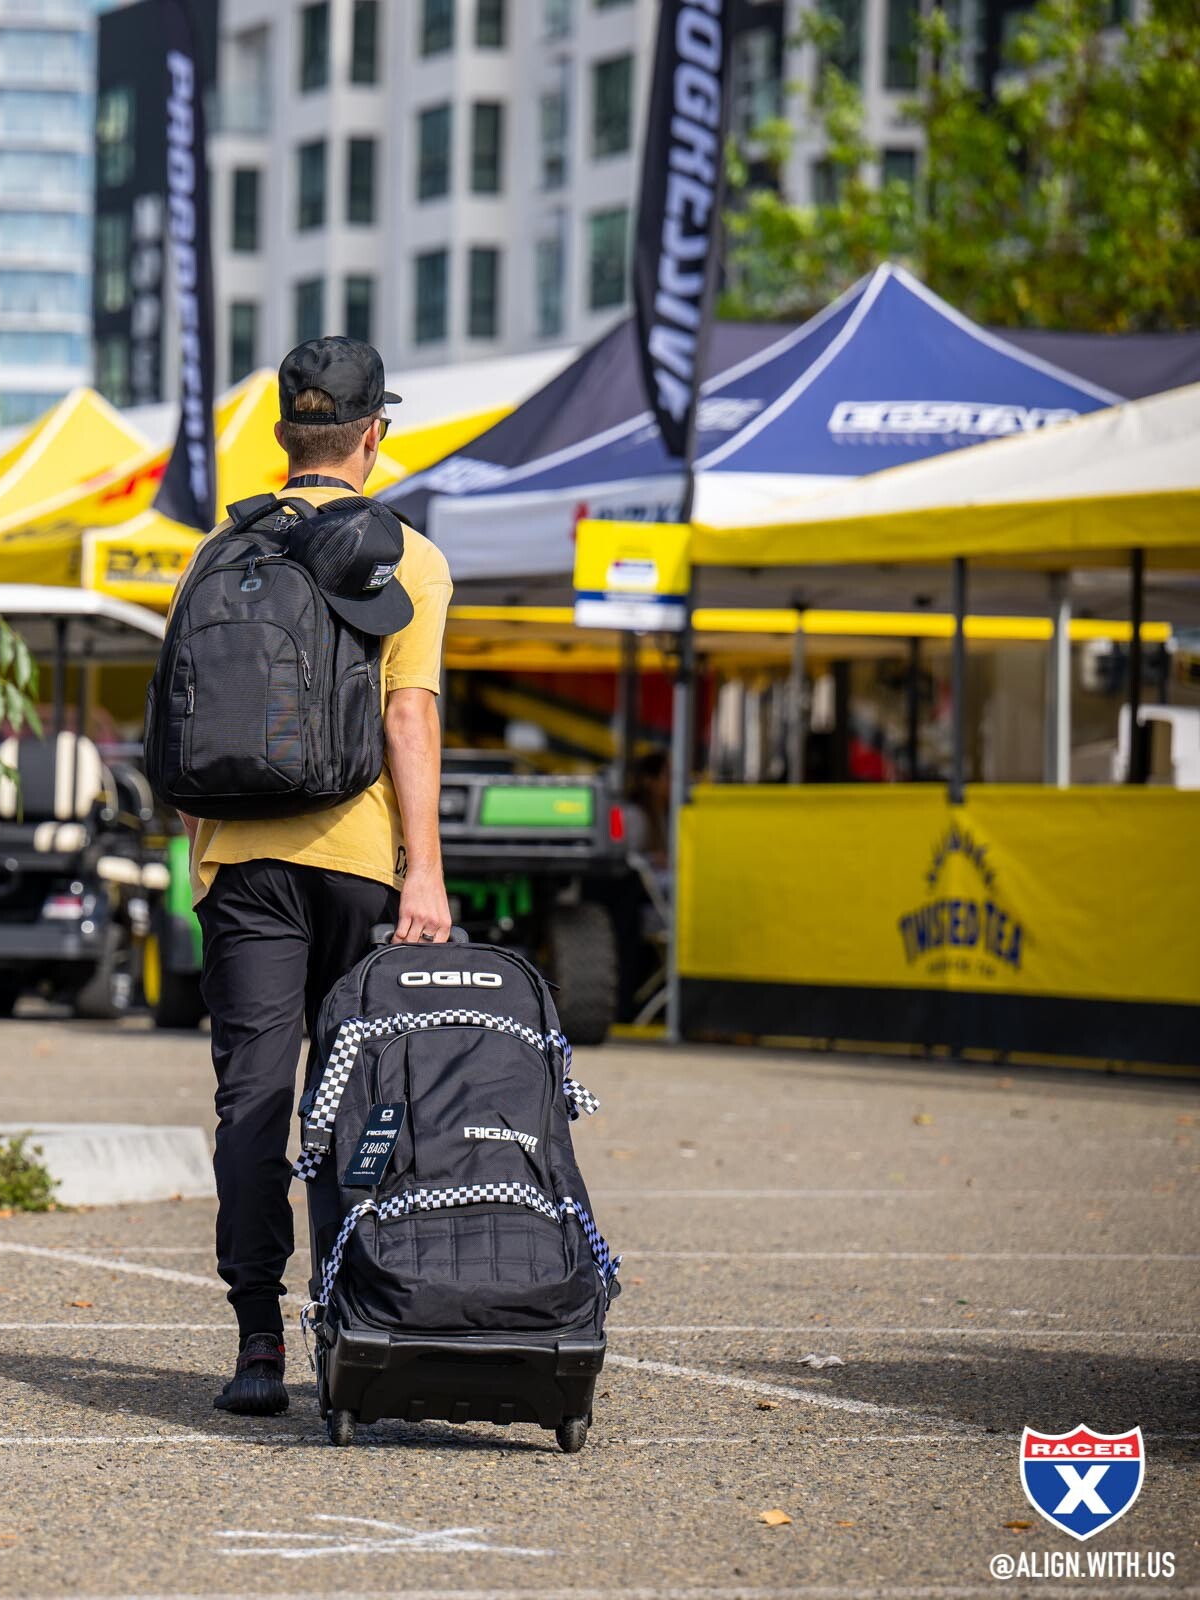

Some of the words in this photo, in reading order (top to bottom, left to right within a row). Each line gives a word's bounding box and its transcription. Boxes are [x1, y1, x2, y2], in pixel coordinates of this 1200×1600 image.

[985, 900, 1024, 973] TEA
[400, 971, 503, 988] OGIO
[360, 1142, 368, 1154] 2
[367, 1142, 390, 1154] BAGS
[360, 1156, 371, 1169] IN
